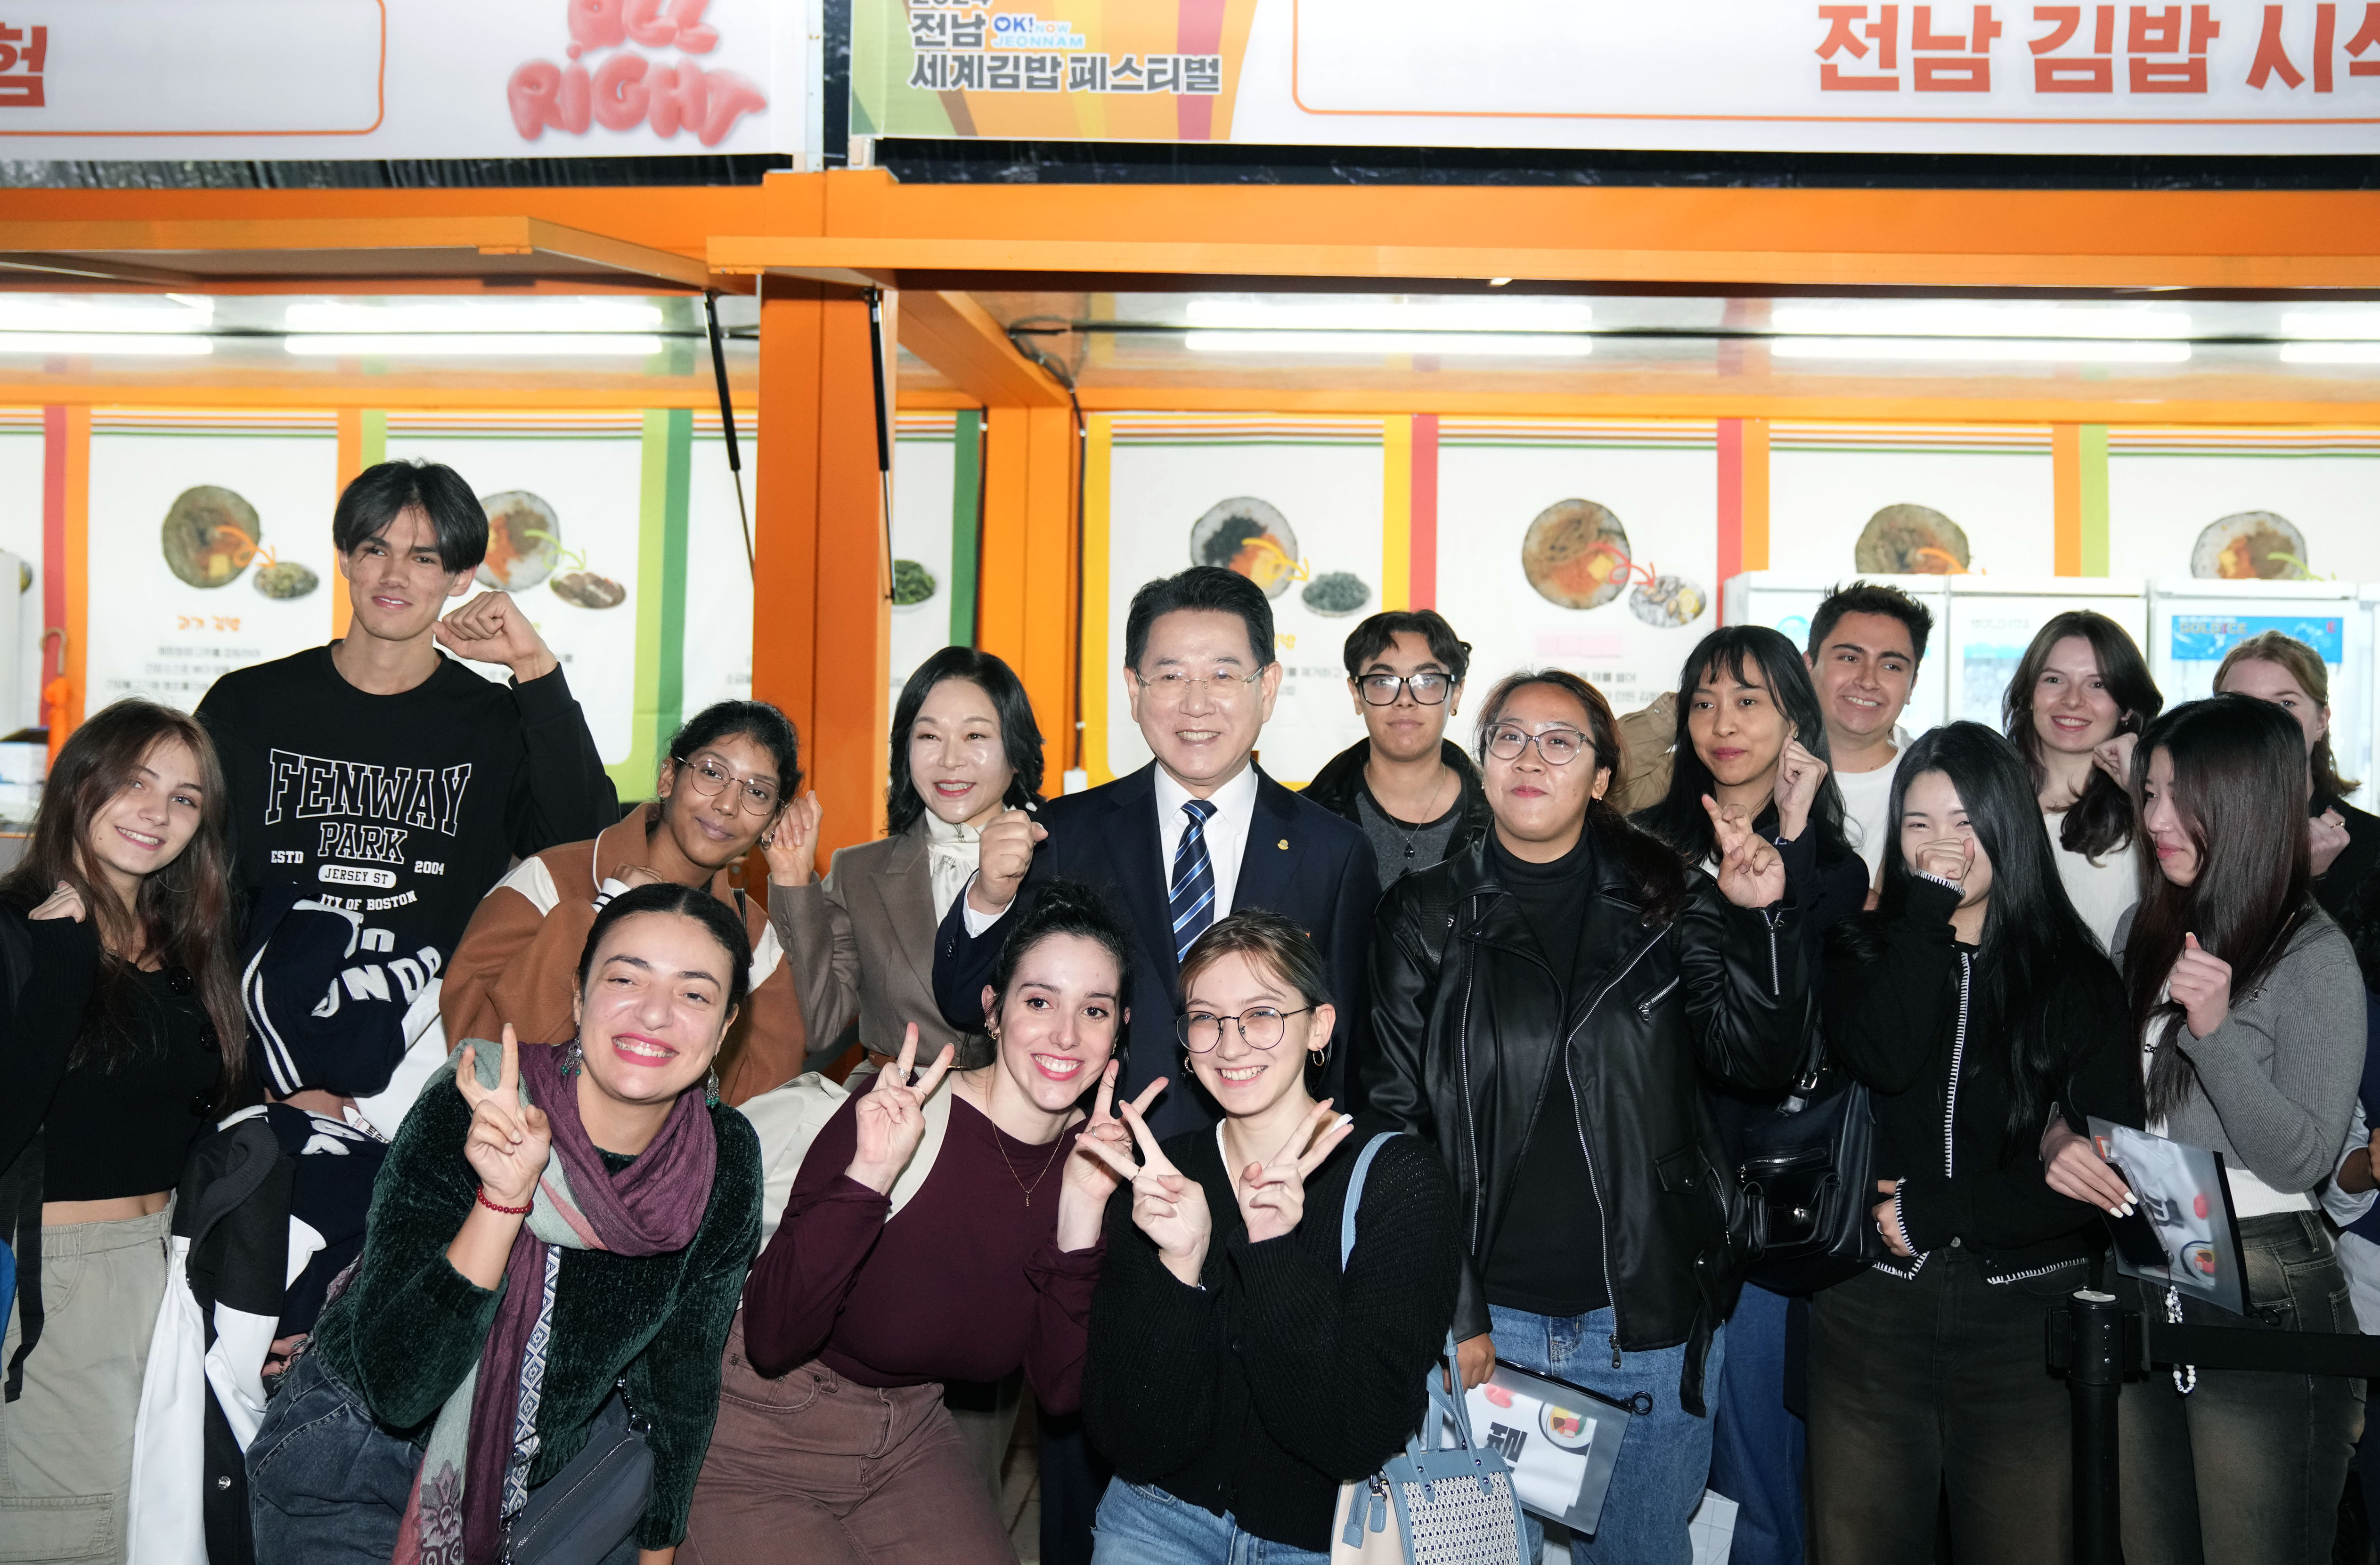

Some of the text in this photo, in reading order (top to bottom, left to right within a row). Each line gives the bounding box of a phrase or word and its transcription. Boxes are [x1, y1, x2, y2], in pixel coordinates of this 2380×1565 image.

[911, 13, 986, 47] 전남
[994, 16, 1033, 32] OK!
[994, 37, 1084, 47] JEONNAM
[1815, 4, 2002, 93] 전남
[2027, 4, 2221, 94] 김밥
[911, 54, 1220, 93] 세계김밥 페스티벌
[265, 748, 471, 836] FENWAY
[318, 822, 408, 865] PARK
[271, 851, 445, 876] ESTD 2004
[325, 868, 388, 884] JERSEY ST
[319, 890, 418, 911] ITY OF BOSTON
